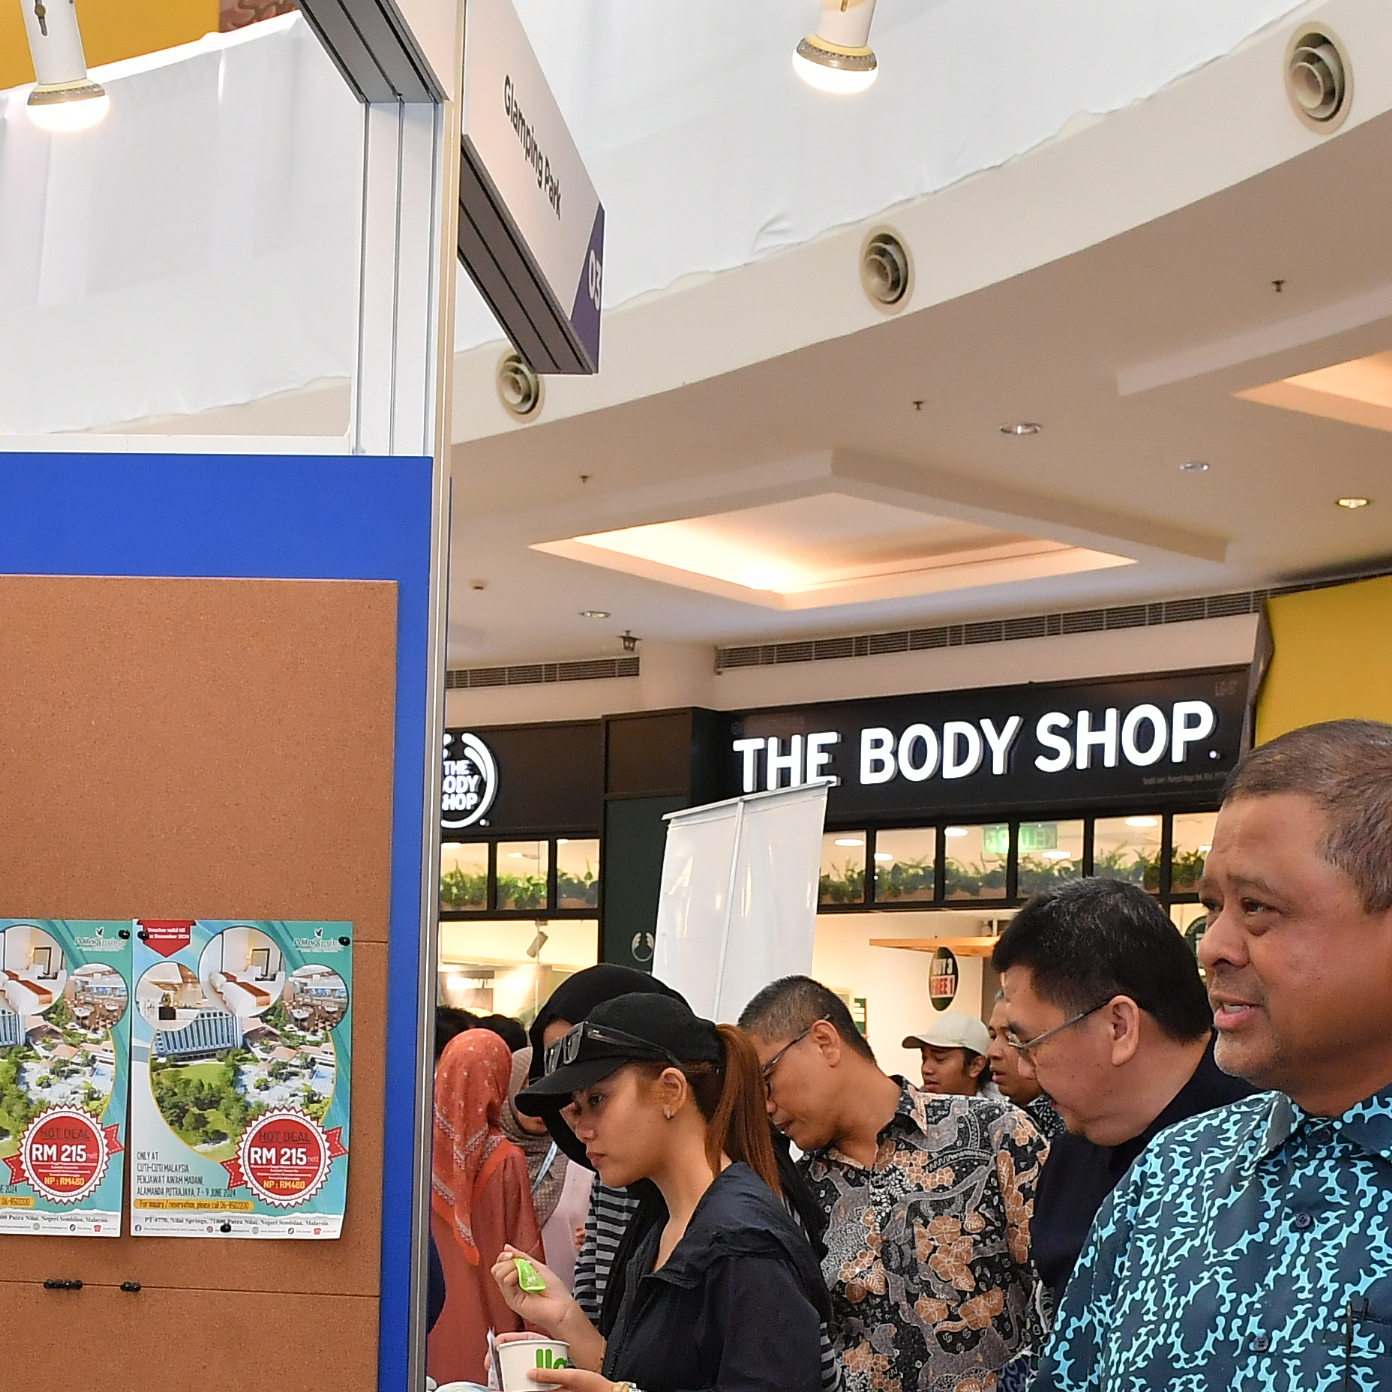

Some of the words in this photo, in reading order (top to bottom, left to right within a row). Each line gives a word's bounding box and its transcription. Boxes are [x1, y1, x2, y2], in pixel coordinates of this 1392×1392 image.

[503, 74, 544, 190] Glamping
[544, 157, 562, 222] Park
[588, 249, 602, 311] 03
[732, 731, 843, 793] THE
[859, 714, 1023, 787] BODY
[442, 759, 471, 775] THE
[441, 774, 480, 794] ODY
[441, 792, 479, 811] HOP
[31, 1143, 57, 1161] RM
[60, 1144, 86, 1162] 215
[250, 1147, 276, 1165] RM
[280, 1147, 307, 1166] 215
[43, 1176, 55, 1185] NP
[263, 1180, 275, 1188] NP
[279, 1180, 306, 1189] RM480
